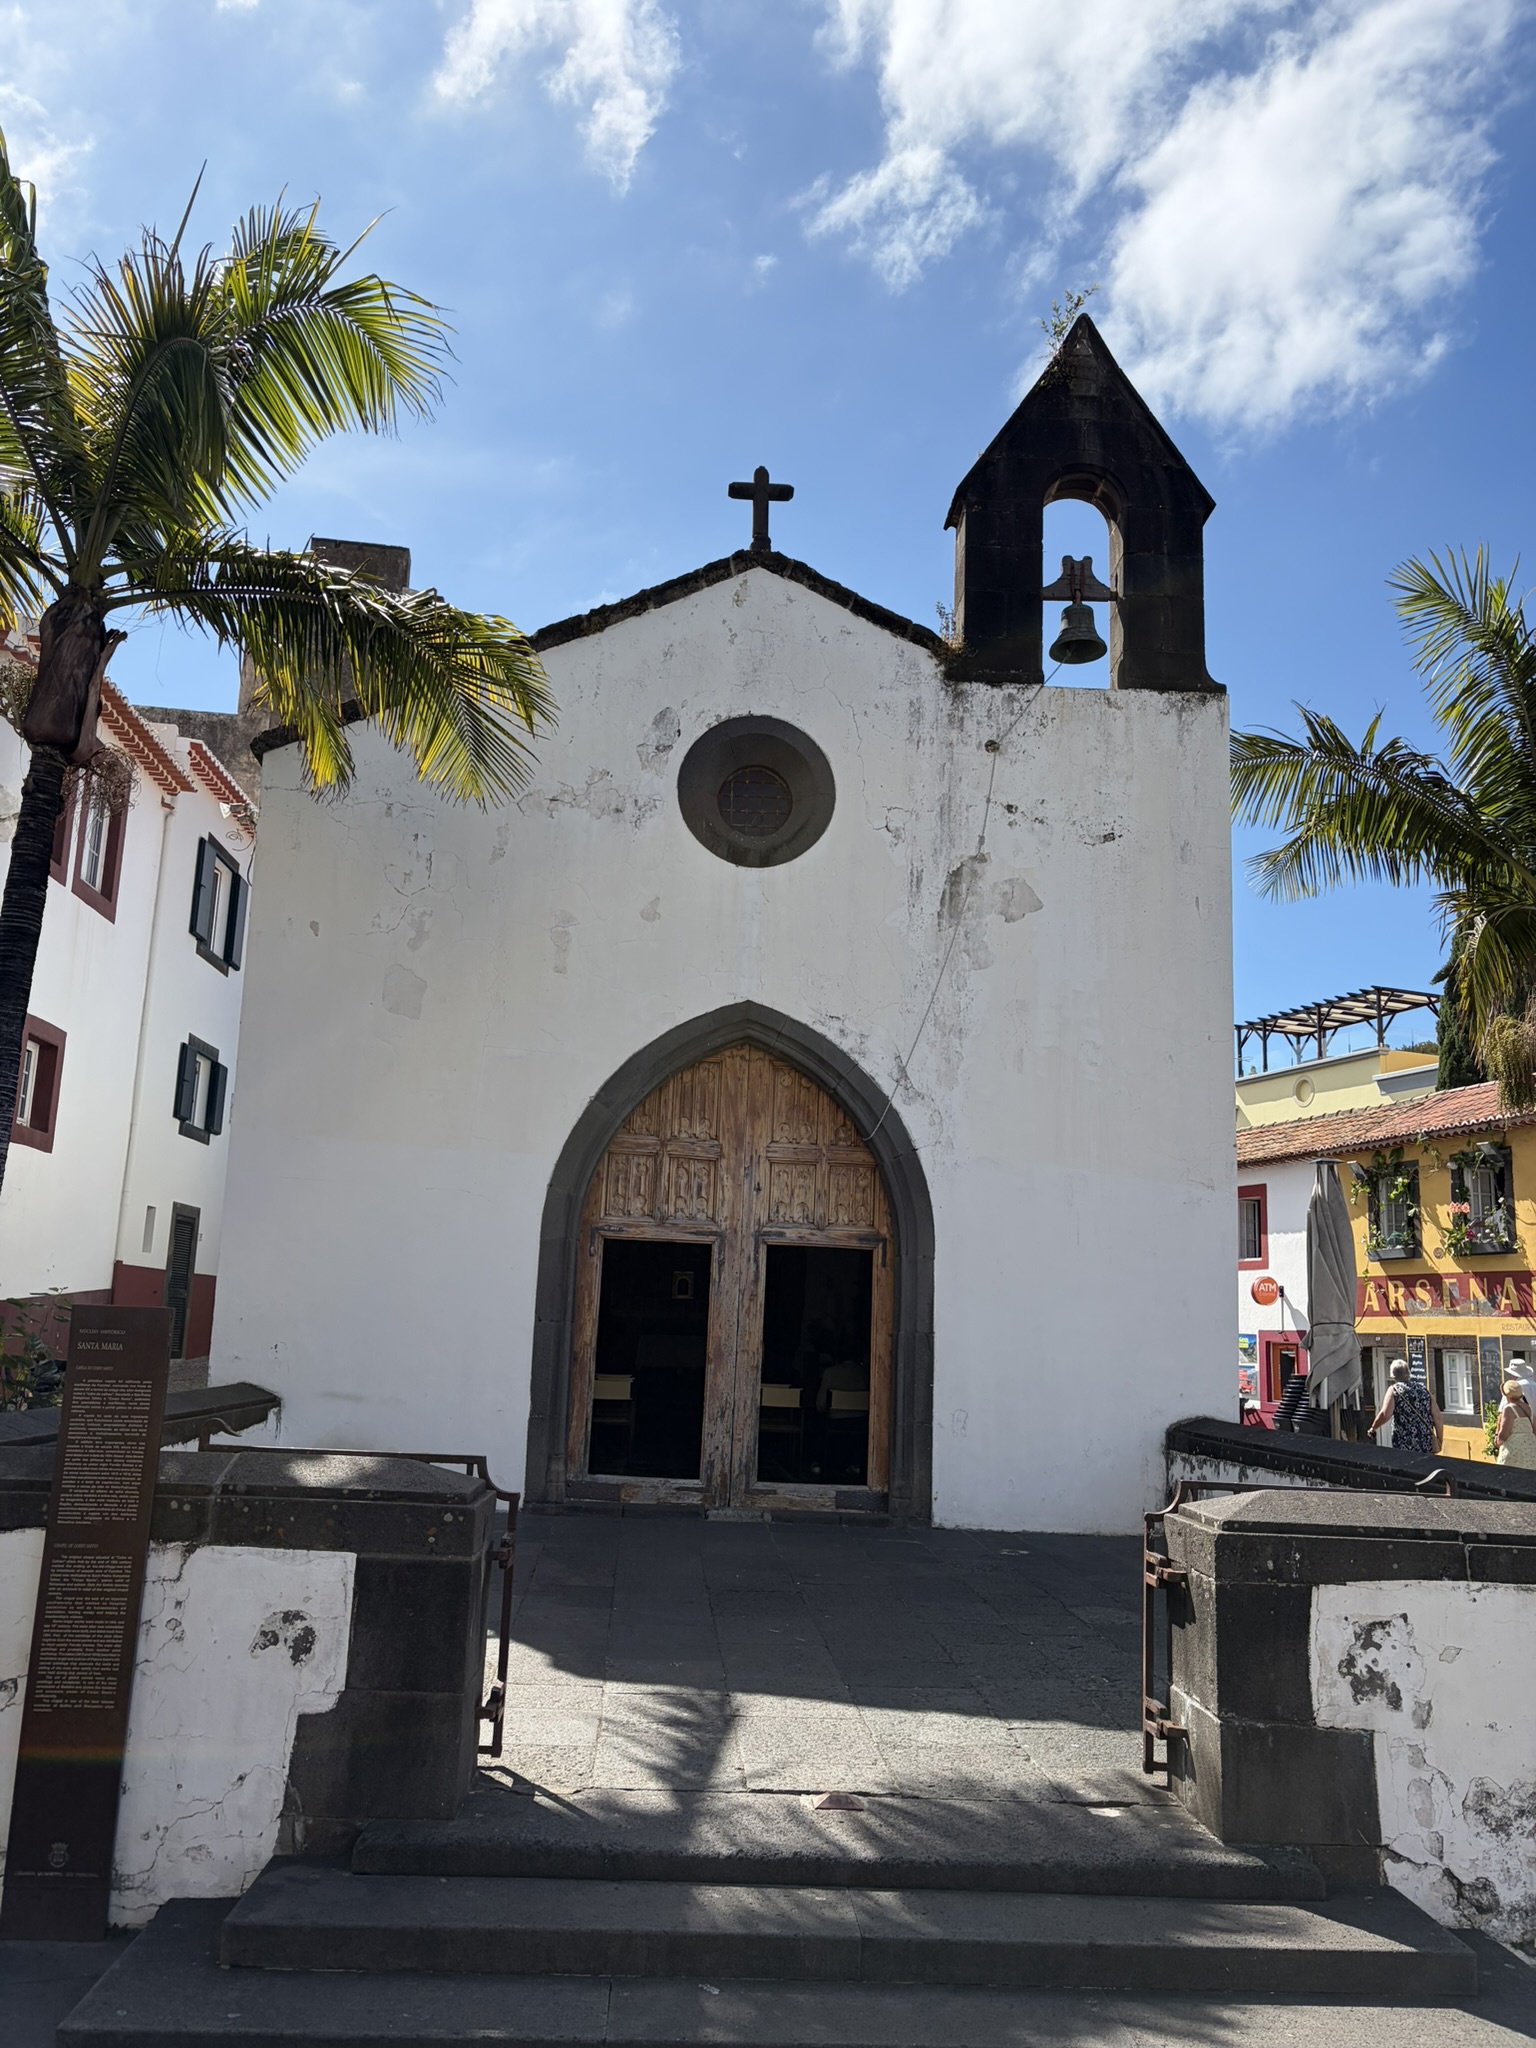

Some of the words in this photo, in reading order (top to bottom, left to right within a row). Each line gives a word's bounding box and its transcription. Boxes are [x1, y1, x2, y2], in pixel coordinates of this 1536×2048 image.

[1259, 1283, 1276, 1292] ATM
[1363, 1276, 1536, 1312] ARSENA
[1502, 1323, 1534, 1331] RESTAUR
[77, 1342, 99, 1350] SANTA
[101, 1342, 123, 1351] MARIA
